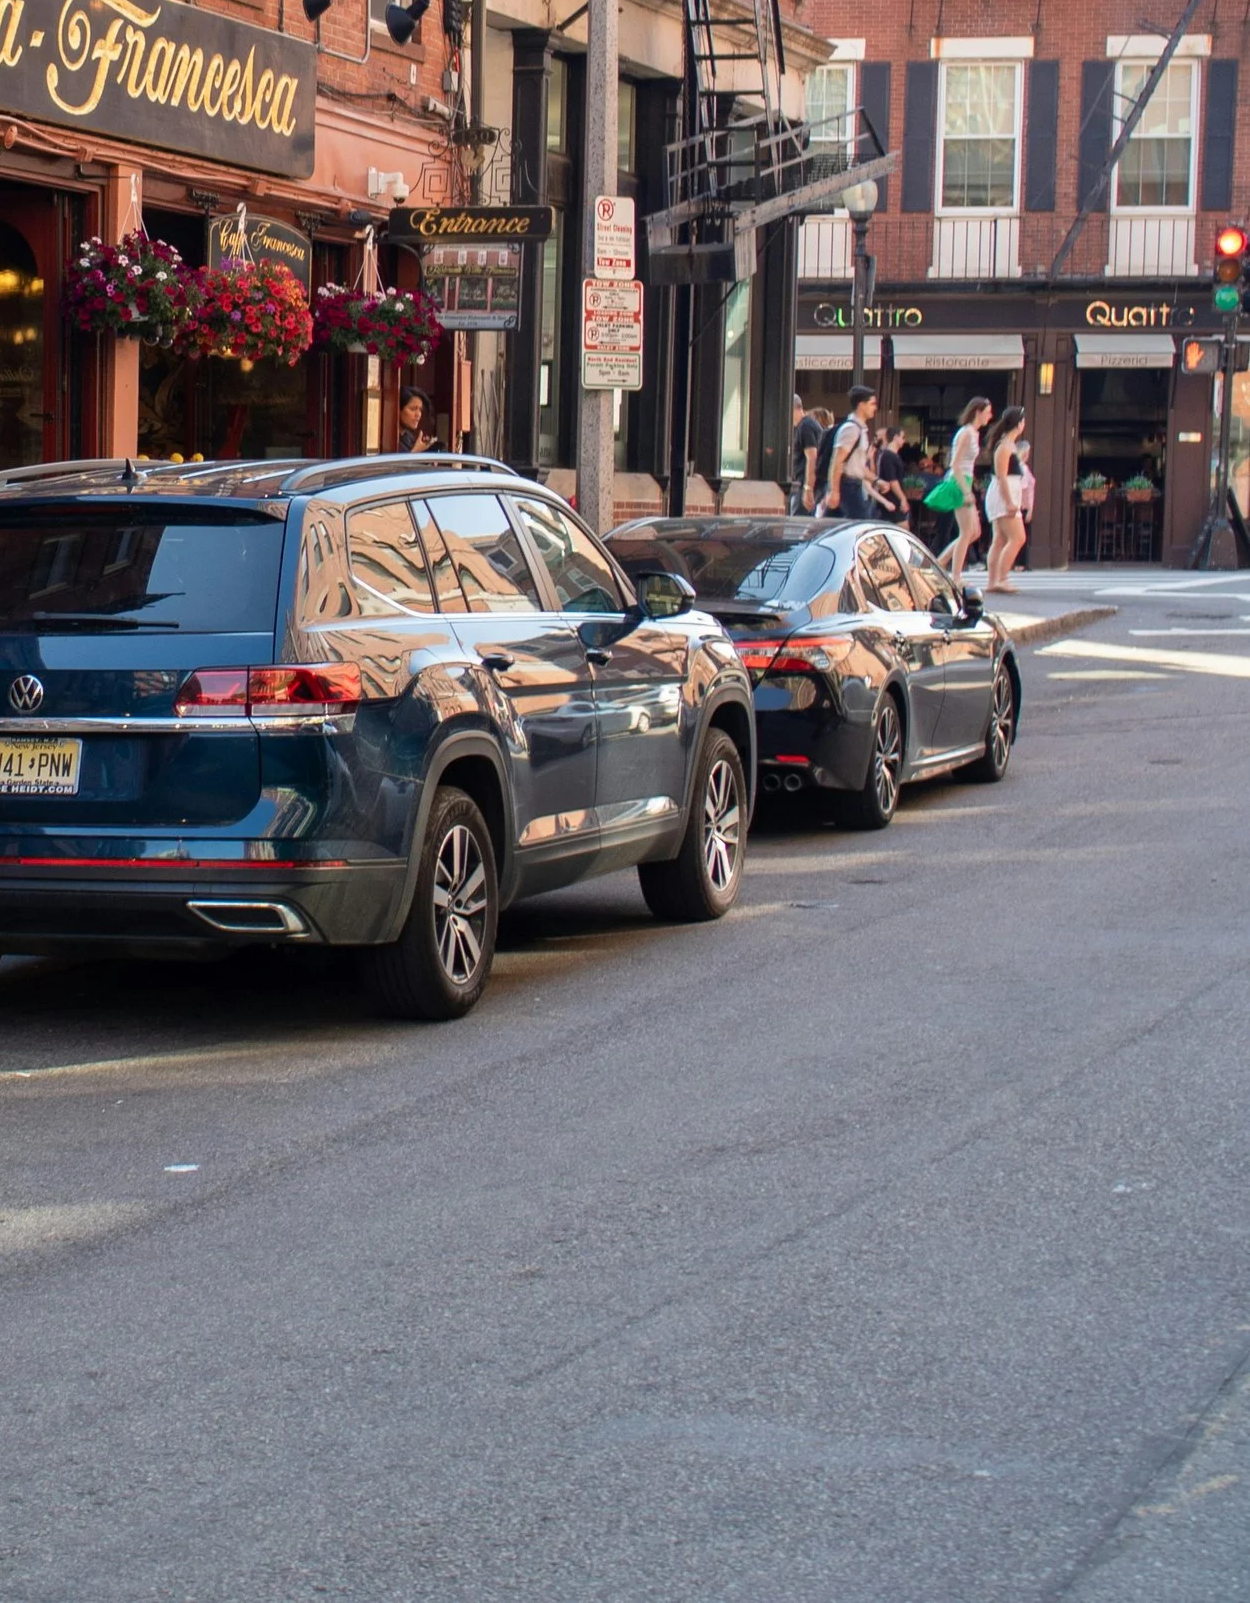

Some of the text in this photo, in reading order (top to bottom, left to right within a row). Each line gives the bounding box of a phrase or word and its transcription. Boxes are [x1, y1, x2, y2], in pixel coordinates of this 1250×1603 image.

[410, 207, 531, 237] Entrance
[813, 302, 923, 328] Quattro
[1085, 301, 1196, 327] Quattro
[925, 355, 990, 368] Ristorante
[1100, 354, 1149, 367] Pizzeria
[31, 743, 58, 751] Jersey
[37, 753, 73, 777] PNW
[11, 785, 74, 794] HEIDT.COM
